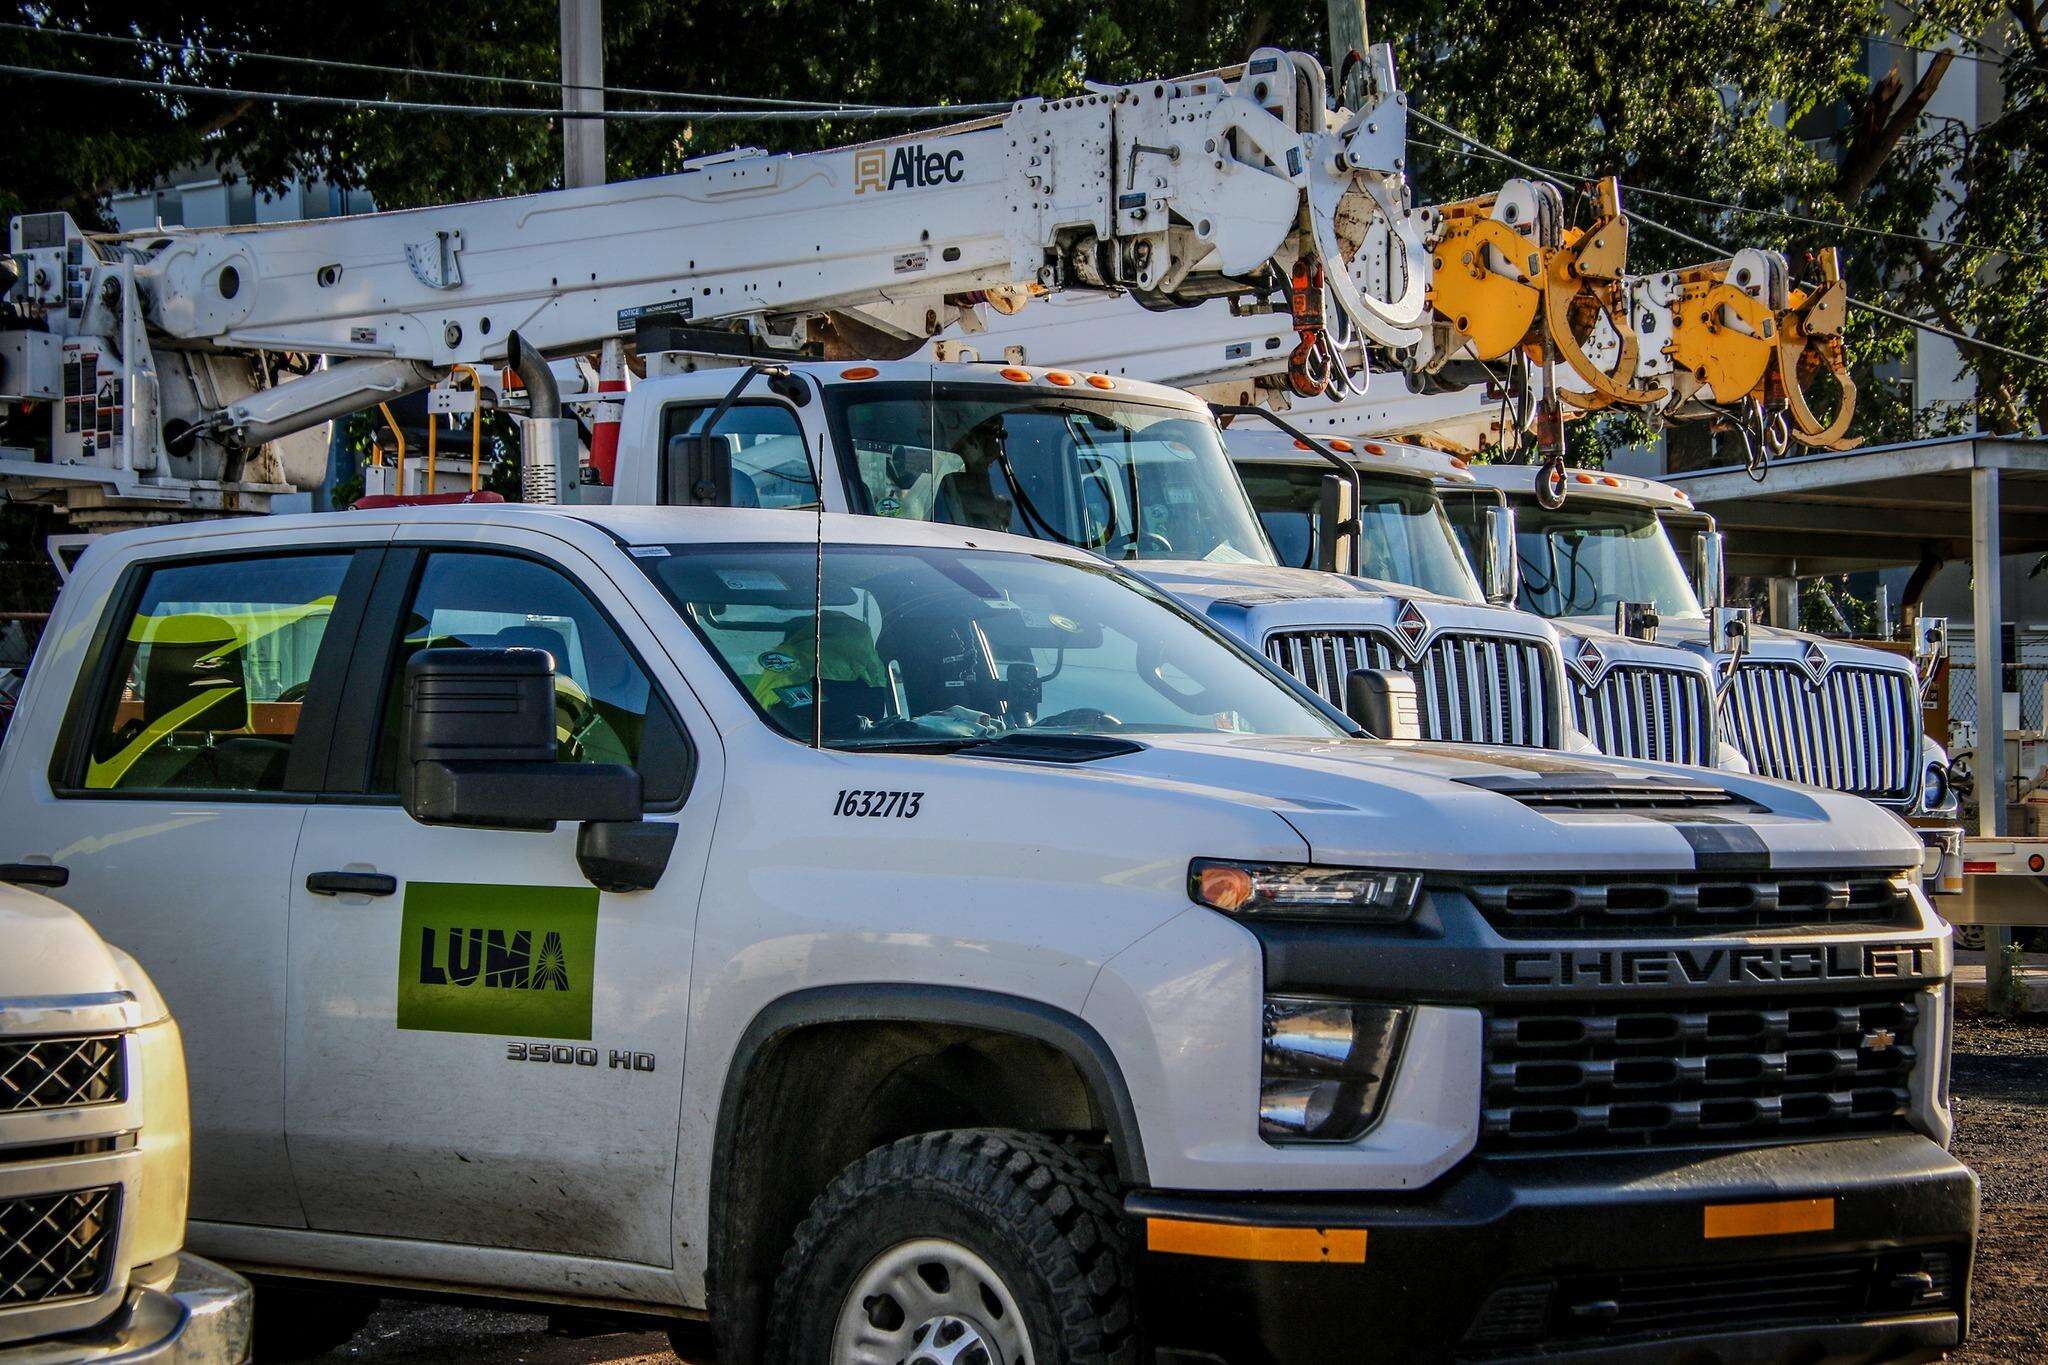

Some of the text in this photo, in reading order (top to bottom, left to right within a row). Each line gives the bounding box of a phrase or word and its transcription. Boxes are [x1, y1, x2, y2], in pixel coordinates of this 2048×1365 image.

[887, 144, 964, 191] Altec
[620, 308, 640, 318] NOTICE
[833, 789, 924, 818] 1632713
[419, 926, 570, 992] LUMA
[1502, 942, 1934, 988] CHEVROLET
[506, 1041, 656, 1073] 3500 HD
